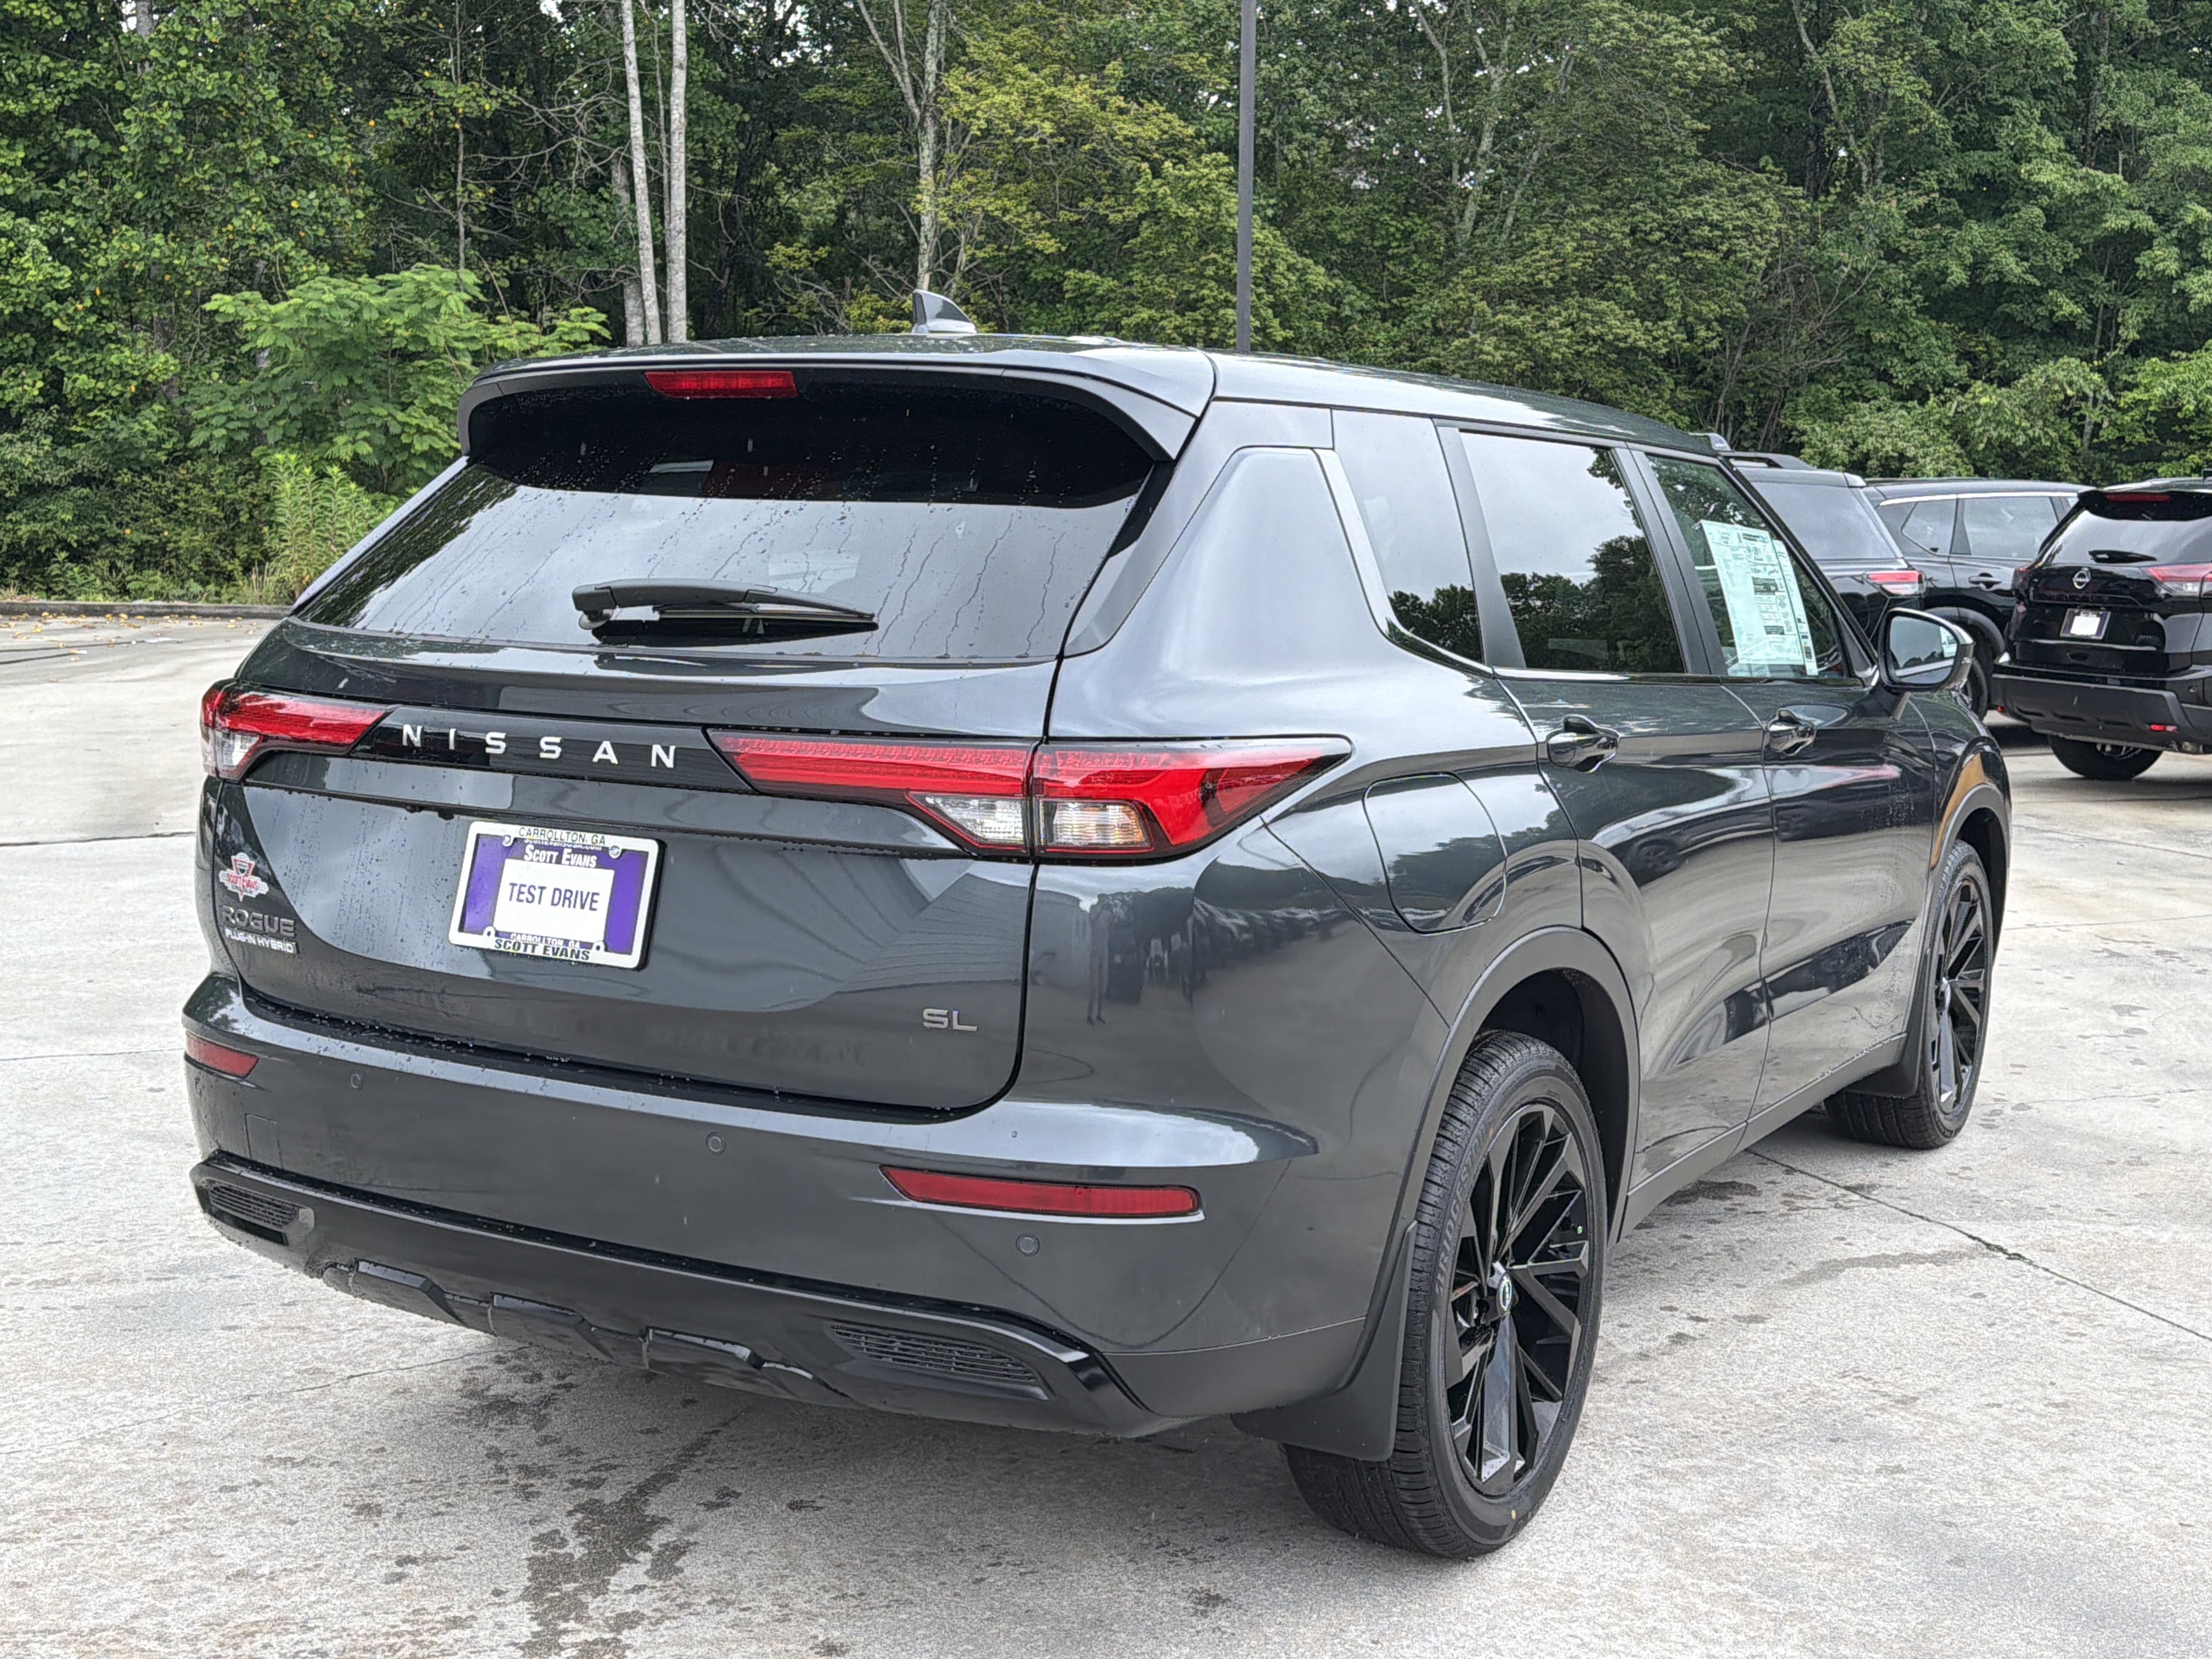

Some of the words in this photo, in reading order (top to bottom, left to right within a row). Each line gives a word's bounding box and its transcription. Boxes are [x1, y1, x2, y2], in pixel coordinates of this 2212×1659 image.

[402, 724, 676, 768] NISSAN
[591, 834, 606, 845] GA
[509, 882, 547, 905] TEST
[550, 887, 600, 911] DRIVE
[220, 904, 295, 938] ROGUE
[257, 936, 295, 953] HYBRID
[494, 938, 539, 954] SCOTT
[543, 945, 591, 961] EVANS
[922, 1008, 979, 1032] SL
